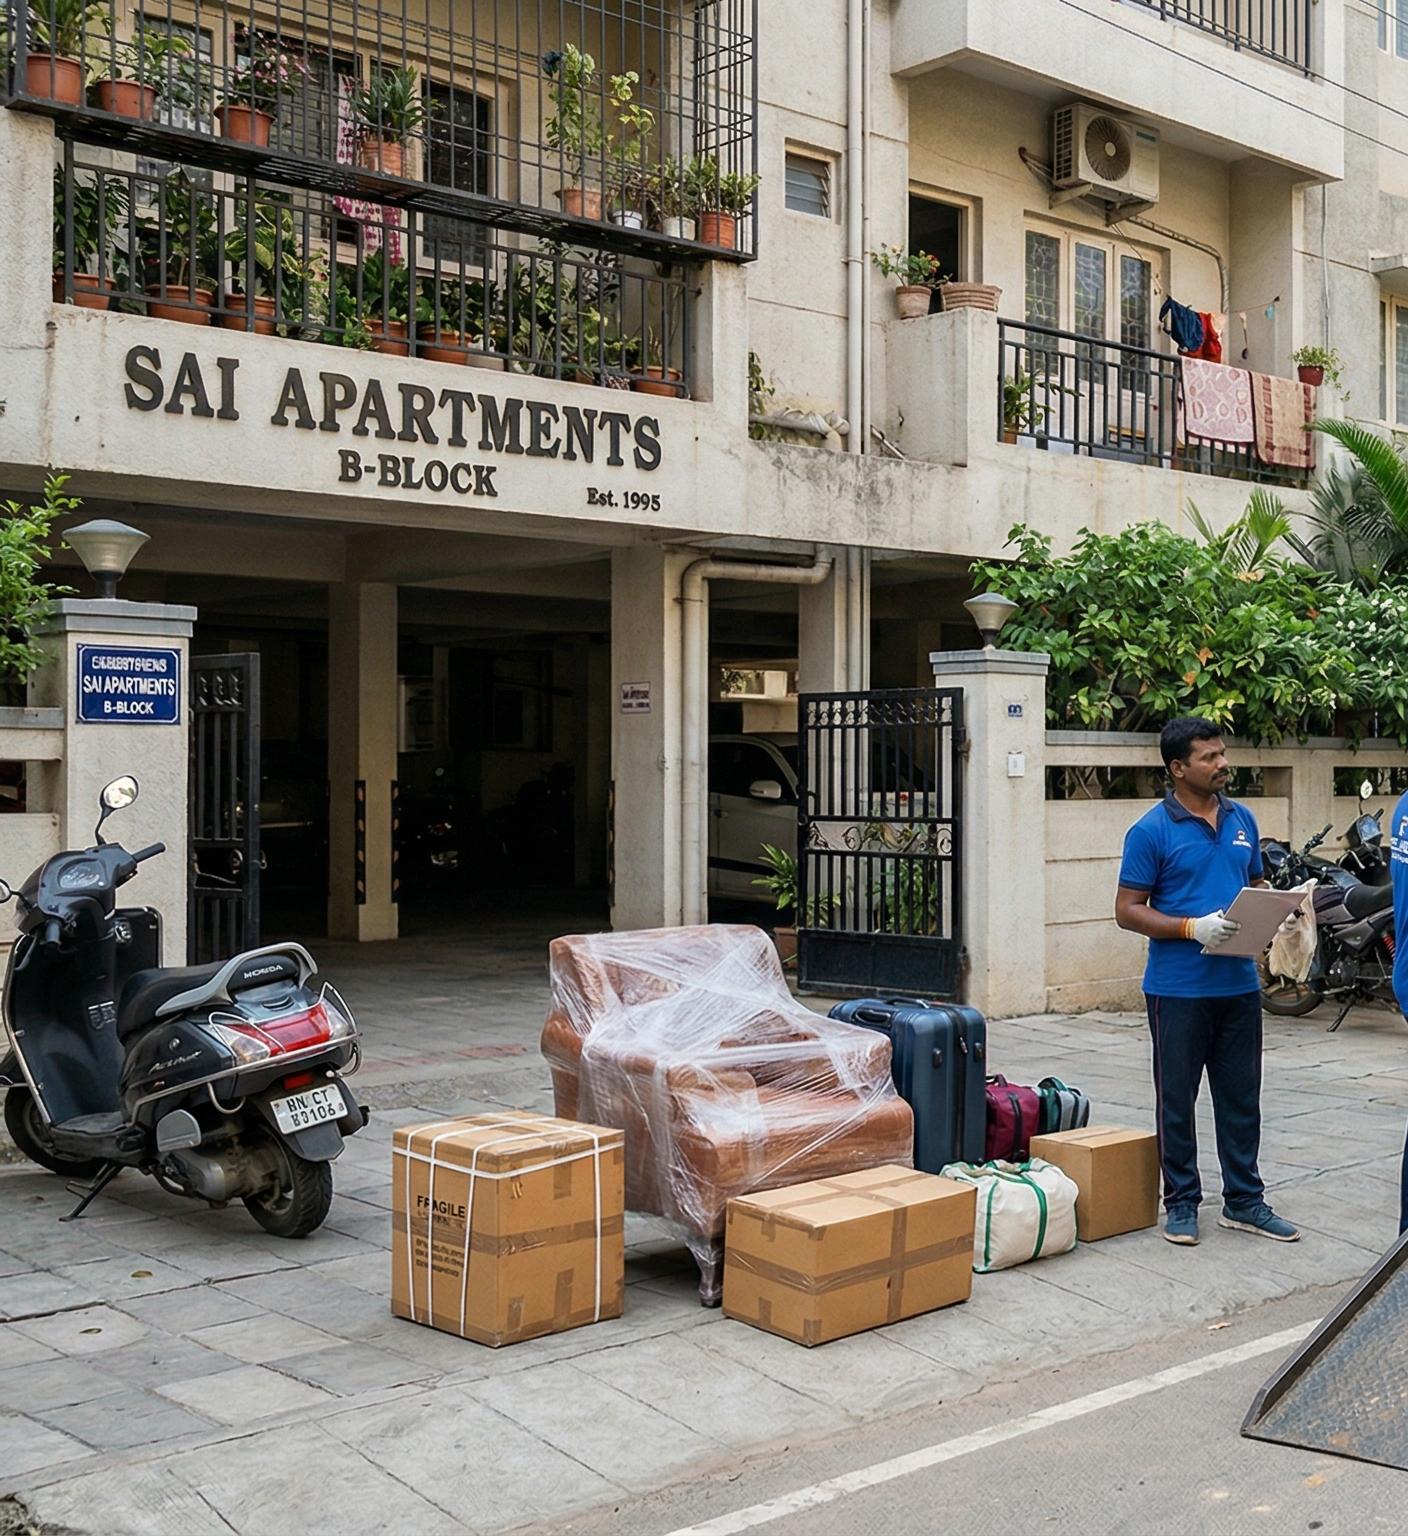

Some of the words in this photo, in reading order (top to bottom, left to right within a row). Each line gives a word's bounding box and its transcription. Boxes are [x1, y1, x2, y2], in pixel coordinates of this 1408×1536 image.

[123, 344, 240, 421] SAI
[270, 367, 662, 471] APARTMENTS
[338, 449, 498, 497] B-BLOCK
[586, 487, 618, 508] Est.
[623, 491, 661, 512] 1995
[83, 674, 102, 694] SAI
[103, 675, 175, 696] APARTMENTS
[104, 700, 154, 715] B-BLOCK
